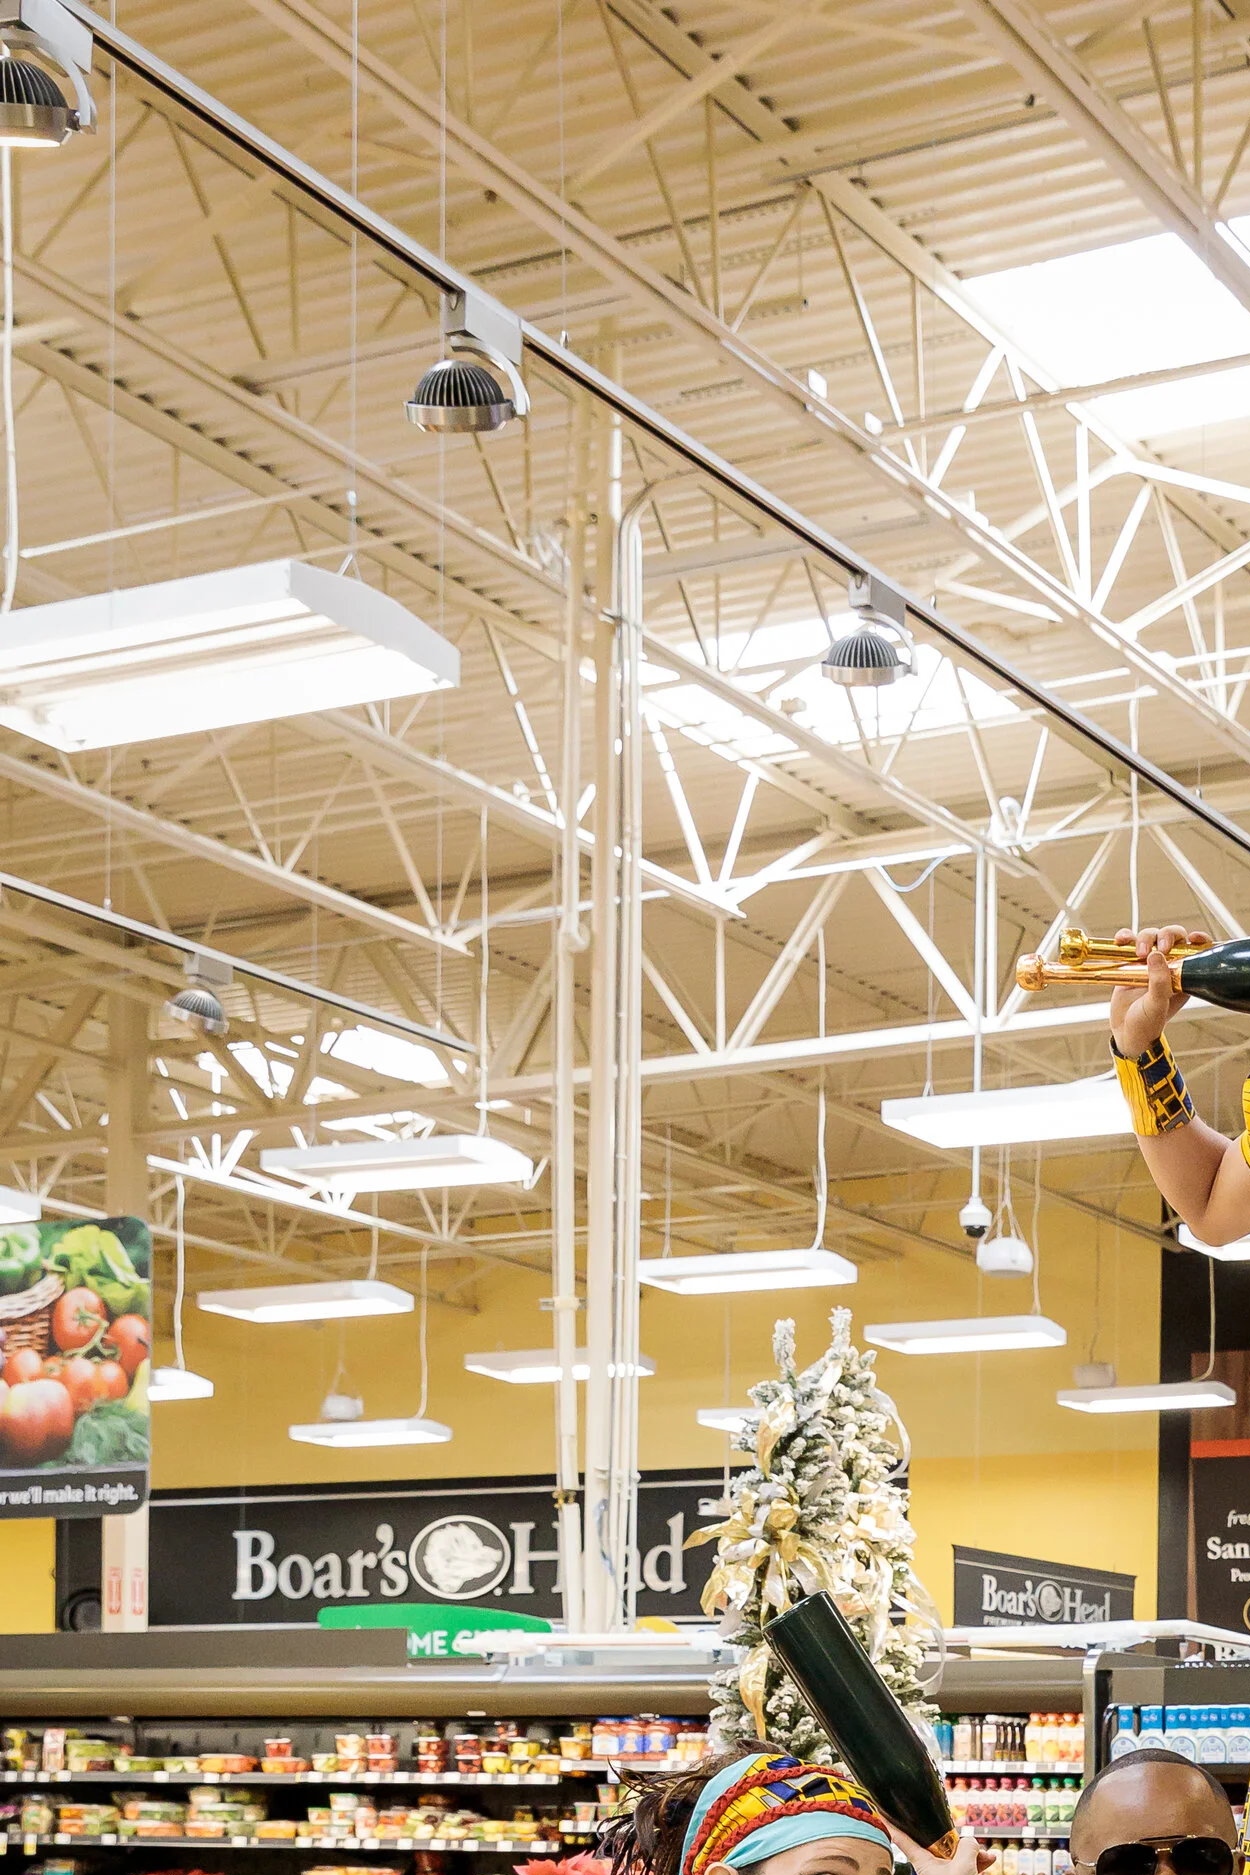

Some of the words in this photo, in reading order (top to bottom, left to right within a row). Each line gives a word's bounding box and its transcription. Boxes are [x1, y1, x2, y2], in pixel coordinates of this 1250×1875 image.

[43, 1484, 84, 1504] make
[84, 1483, 97, 1502] it
[97, 1482, 139, 1505] right.
[231, 1522, 409, 1600] Boar's
[981, 1573, 1037, 1617] Boar's
[1063, 1587, 1111, 1622] Head
